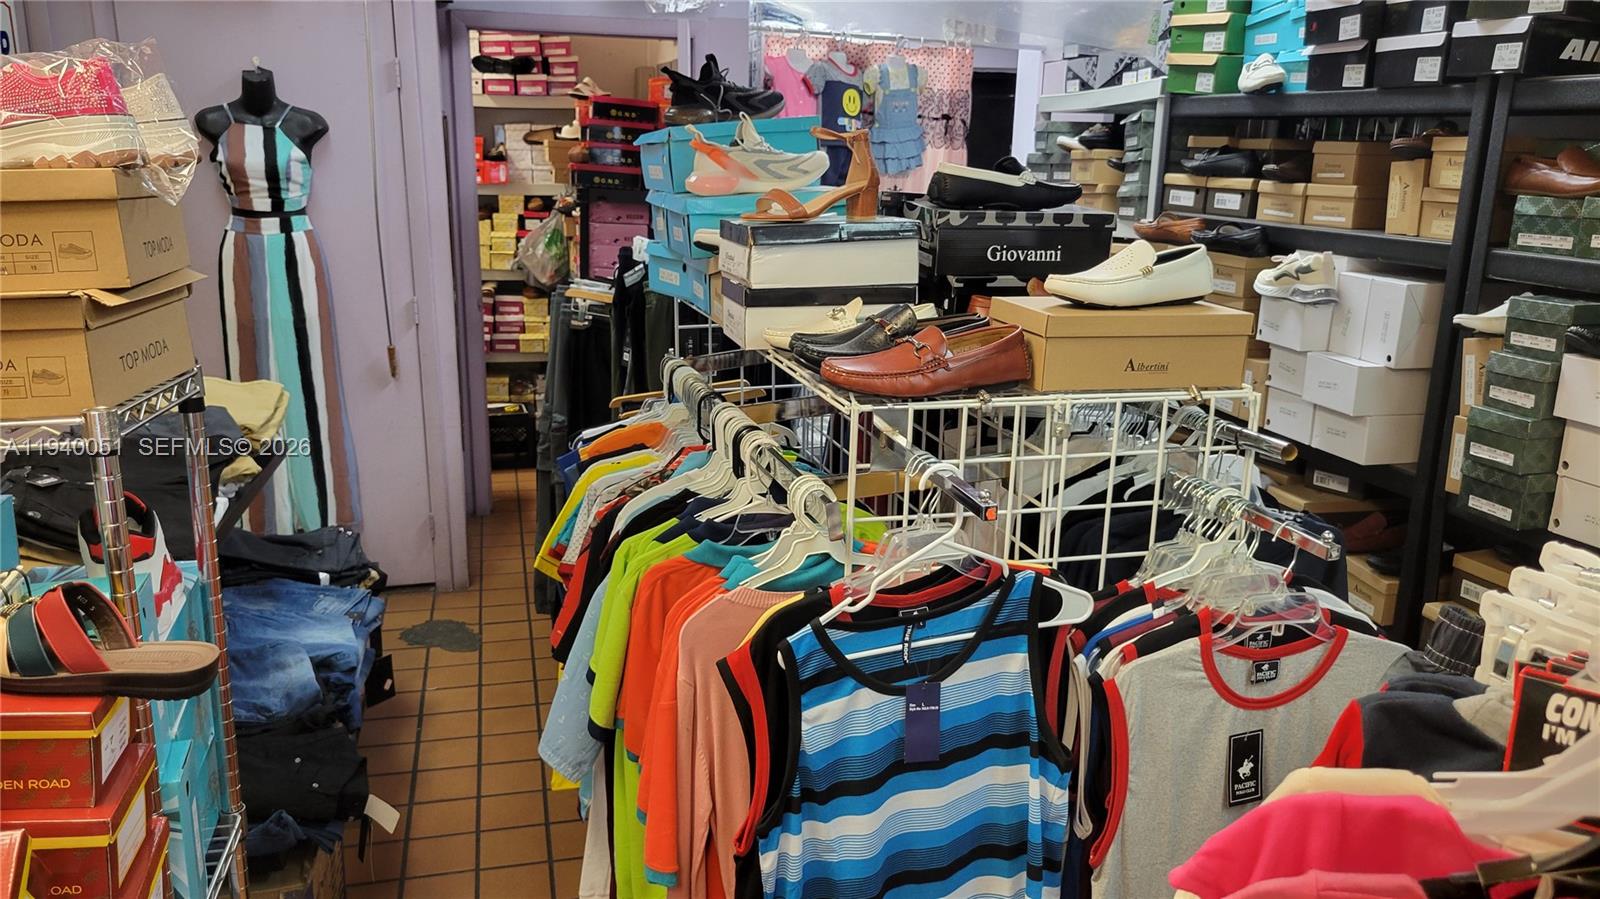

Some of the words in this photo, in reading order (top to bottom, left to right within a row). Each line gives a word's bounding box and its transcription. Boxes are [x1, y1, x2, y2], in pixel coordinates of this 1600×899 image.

[155, 236, 174, 252] MODA
[987, 245, 1062, 262] Giovanni
[119, 352, 139, 372] TOP
[141, 339, 170, 362] MODA
[1124, 358, 1170, 372] Albertini
[1541, 722, 1577, 746] I'M
[28, 778, 71, 790] ROAD
[1234, 780, 1257, 791] PACIFIC
